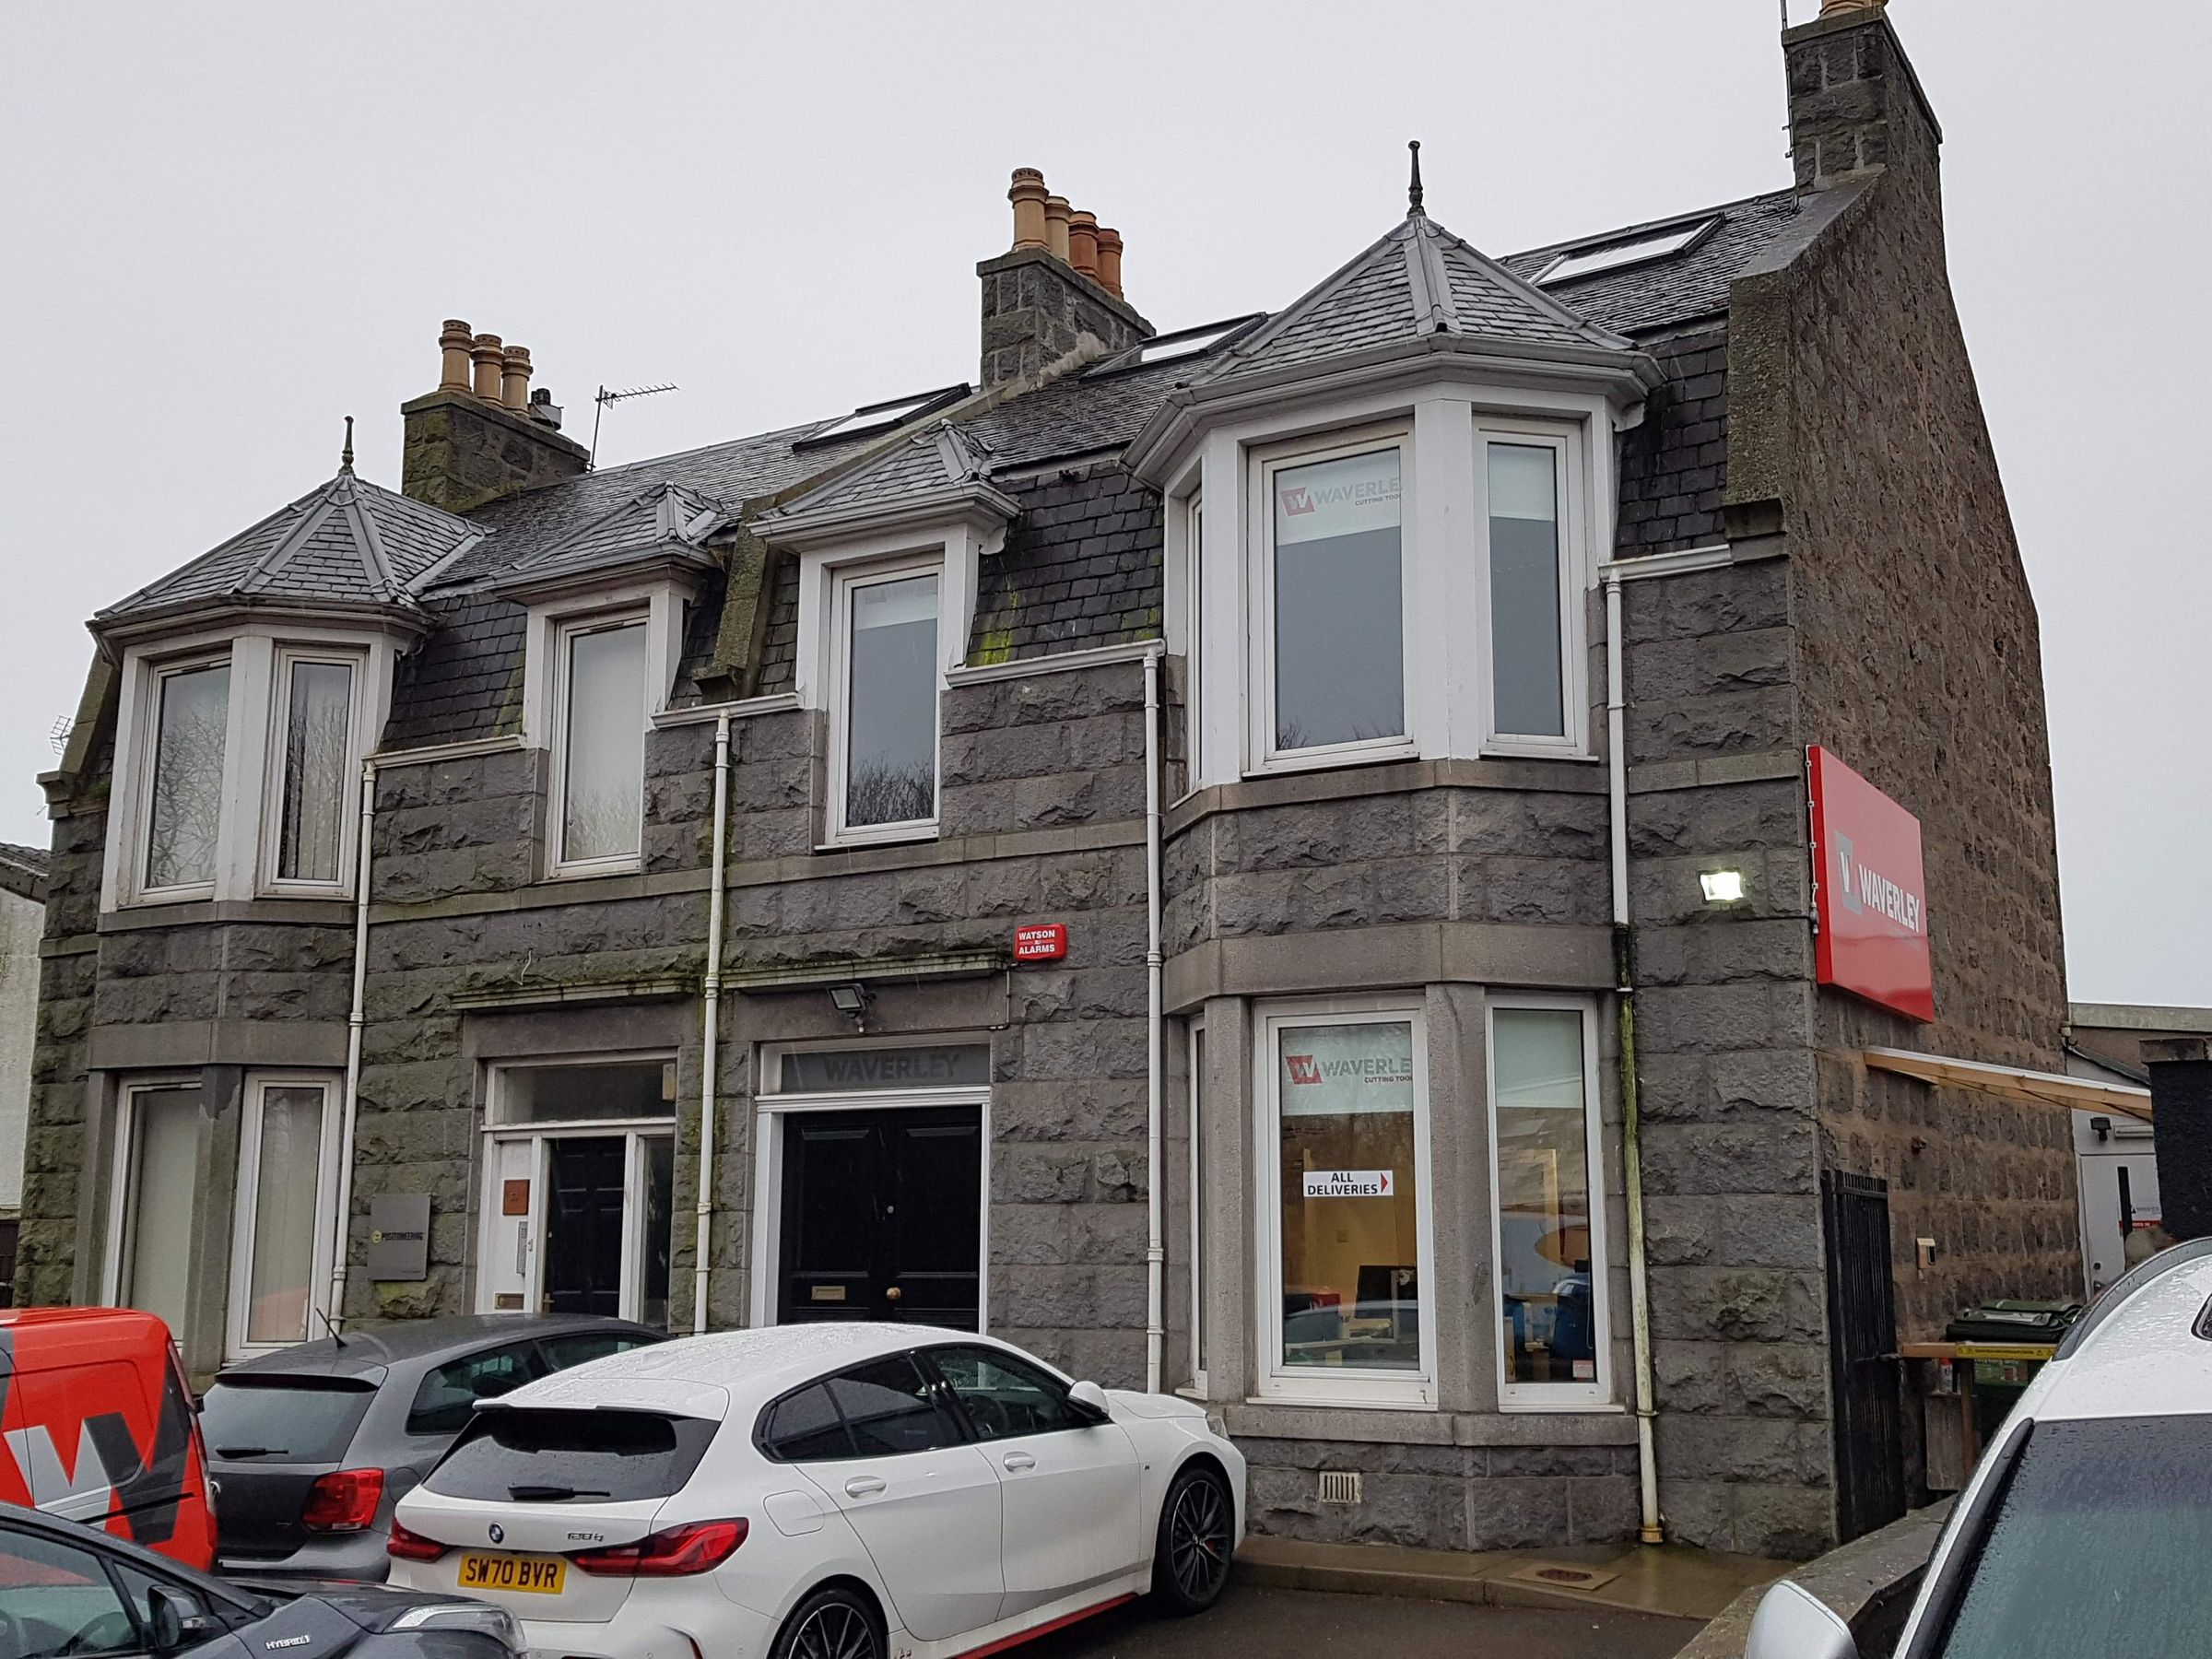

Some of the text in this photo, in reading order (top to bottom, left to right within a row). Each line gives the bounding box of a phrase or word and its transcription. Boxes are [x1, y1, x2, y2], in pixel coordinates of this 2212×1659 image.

[1355, 496, 1383, 506] CUTTING
[1858, 864, 1920, 933] WAVERLEY
[1018, 930, 1055, 940] WATSON
[1018, 944, 1055, 955] ALARMS
[822, 1053, 961, 1081] WAVERLEY
[1322, 1057, 1412, 1077] WAVERLE
[1364, 1076, 1394, 1084] CUTTING
[1331, 1172, 1354, 1182] ALL
[1307, 1184, 1378, 1195] DELIVERIES
[465, 1558, 559, 1588] SW70 BVR
